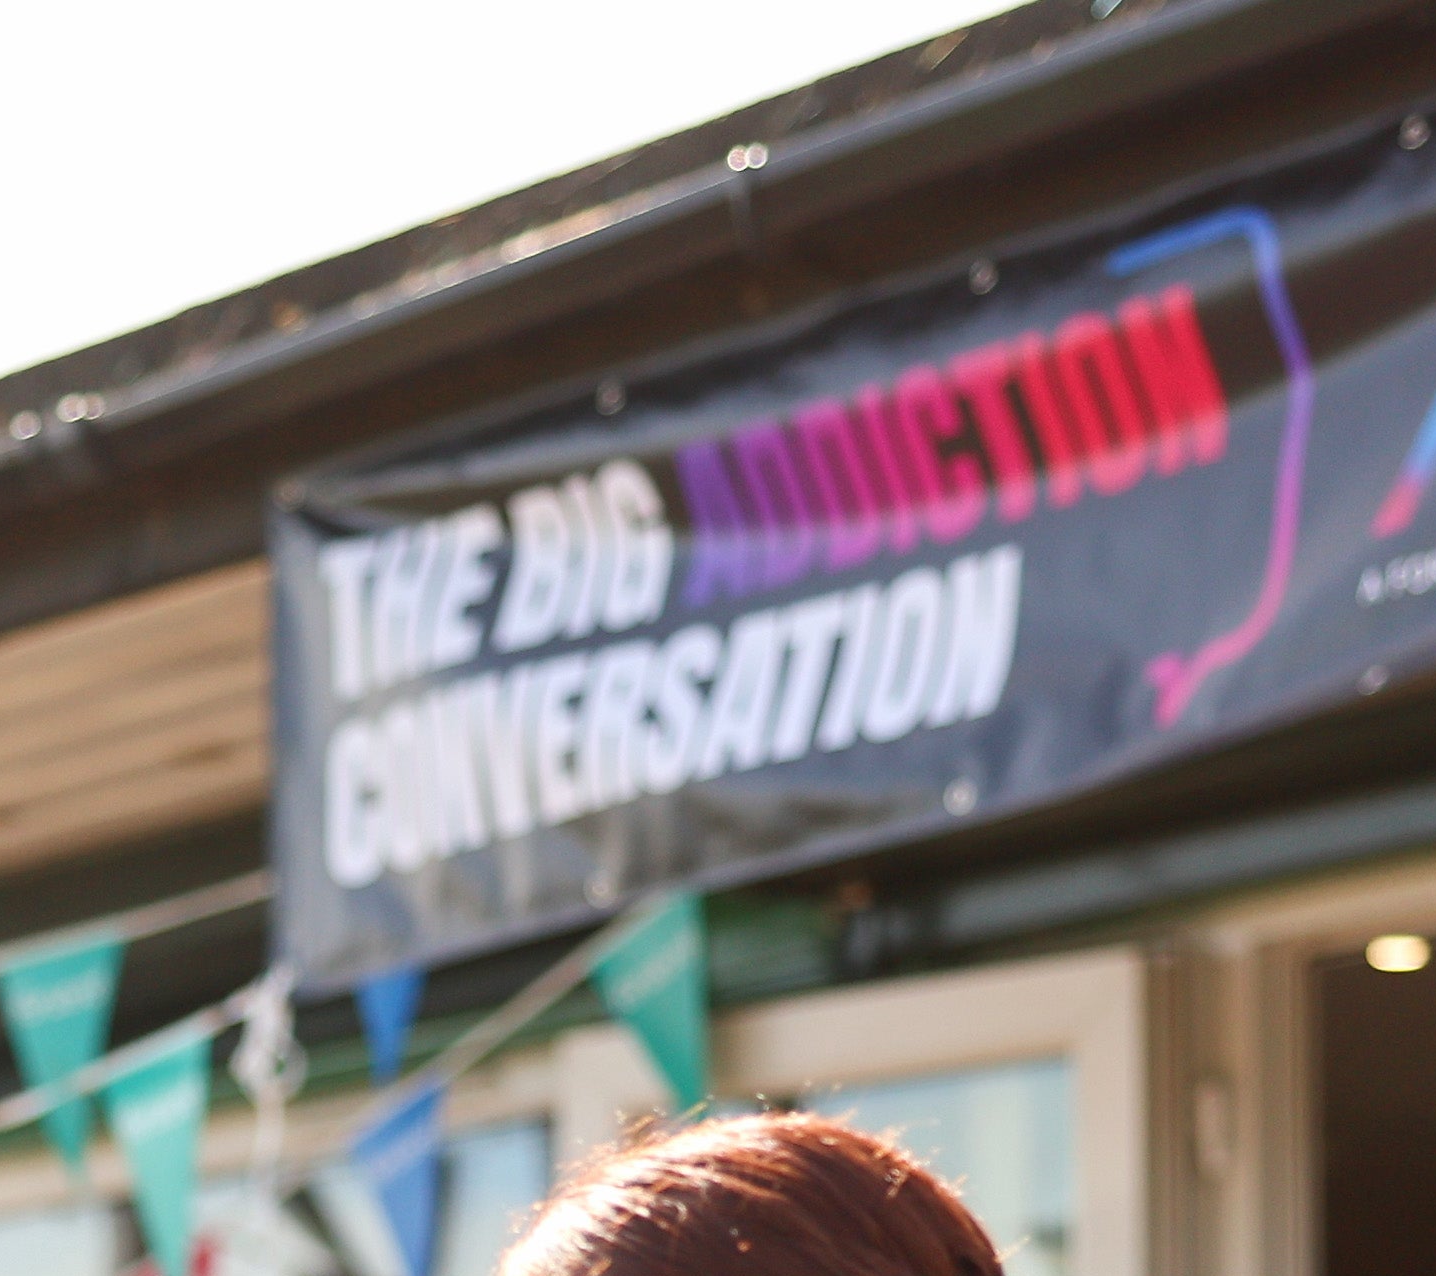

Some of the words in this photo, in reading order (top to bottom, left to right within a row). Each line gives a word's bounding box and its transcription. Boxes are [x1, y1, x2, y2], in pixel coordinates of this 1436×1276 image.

[319, 502, 503, 697] THE
[492, 458, 675, 652] BIG
[677, 283, 1228, 603] ADDICTION
[325, 544, 1021, 888] CONVERSATION
